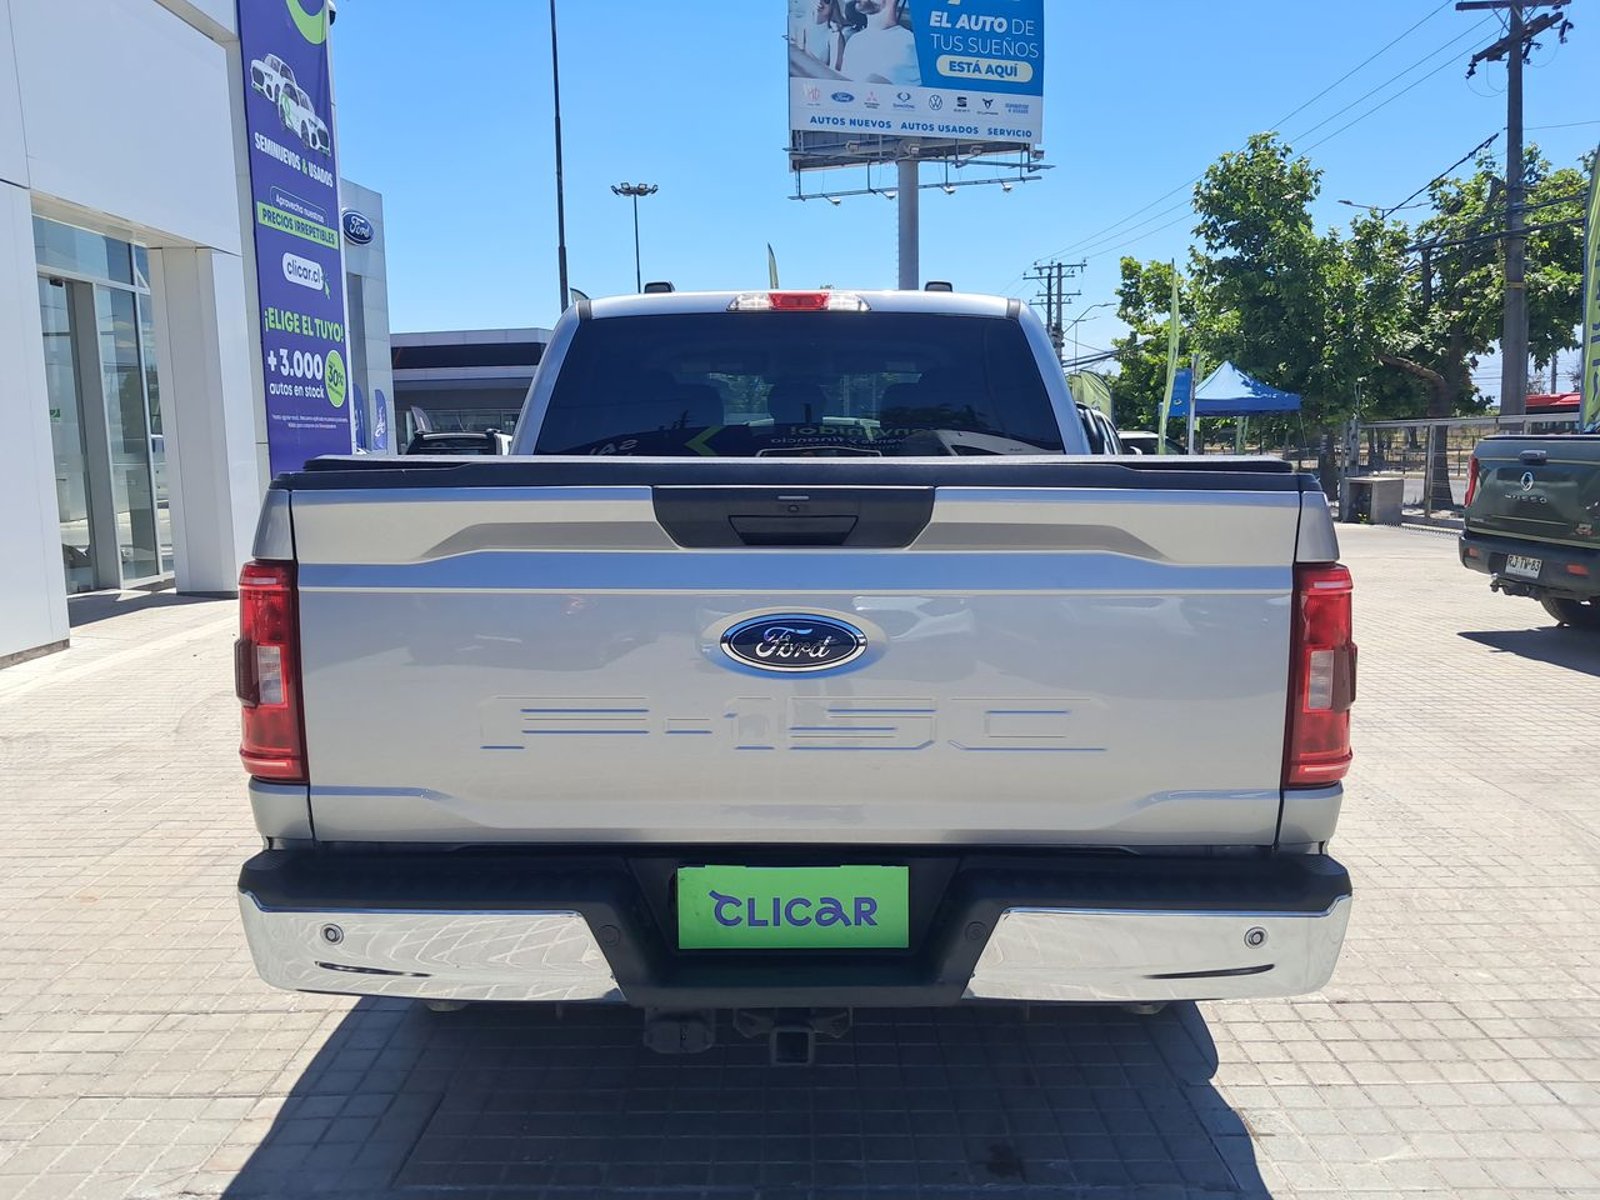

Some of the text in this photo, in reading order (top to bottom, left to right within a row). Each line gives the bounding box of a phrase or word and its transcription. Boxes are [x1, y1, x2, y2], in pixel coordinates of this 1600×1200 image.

[929, 11, 1035, 36] EL AUTO DE
[930, 33, 1039, 58] TUS SUEÑOS
[949, 59, 1018, 78] ESTÁ AQUÍ
[810, 116, 1032, 138] AUTOS NUEVOS AUTOS USADOS SERVICIO
[255, 132, 333, 188] SEMINUEVOS & USADOS
[262, 207, 335, 246] PRECIOS IRREPETIBLES
[286, 260, 321, 283] clicar.cl
[265, 307, 344, 343] ¡ELIGE EL TUYO!
[279, 349, 323, 381] 3.000
[270, 382, 293, 397] autos
[294, 385, 303, 397] en
[303, 384, 325, 399] stock
[755, 626, 832, 661] Ford
[480, 696, 1108, 751] F-150
